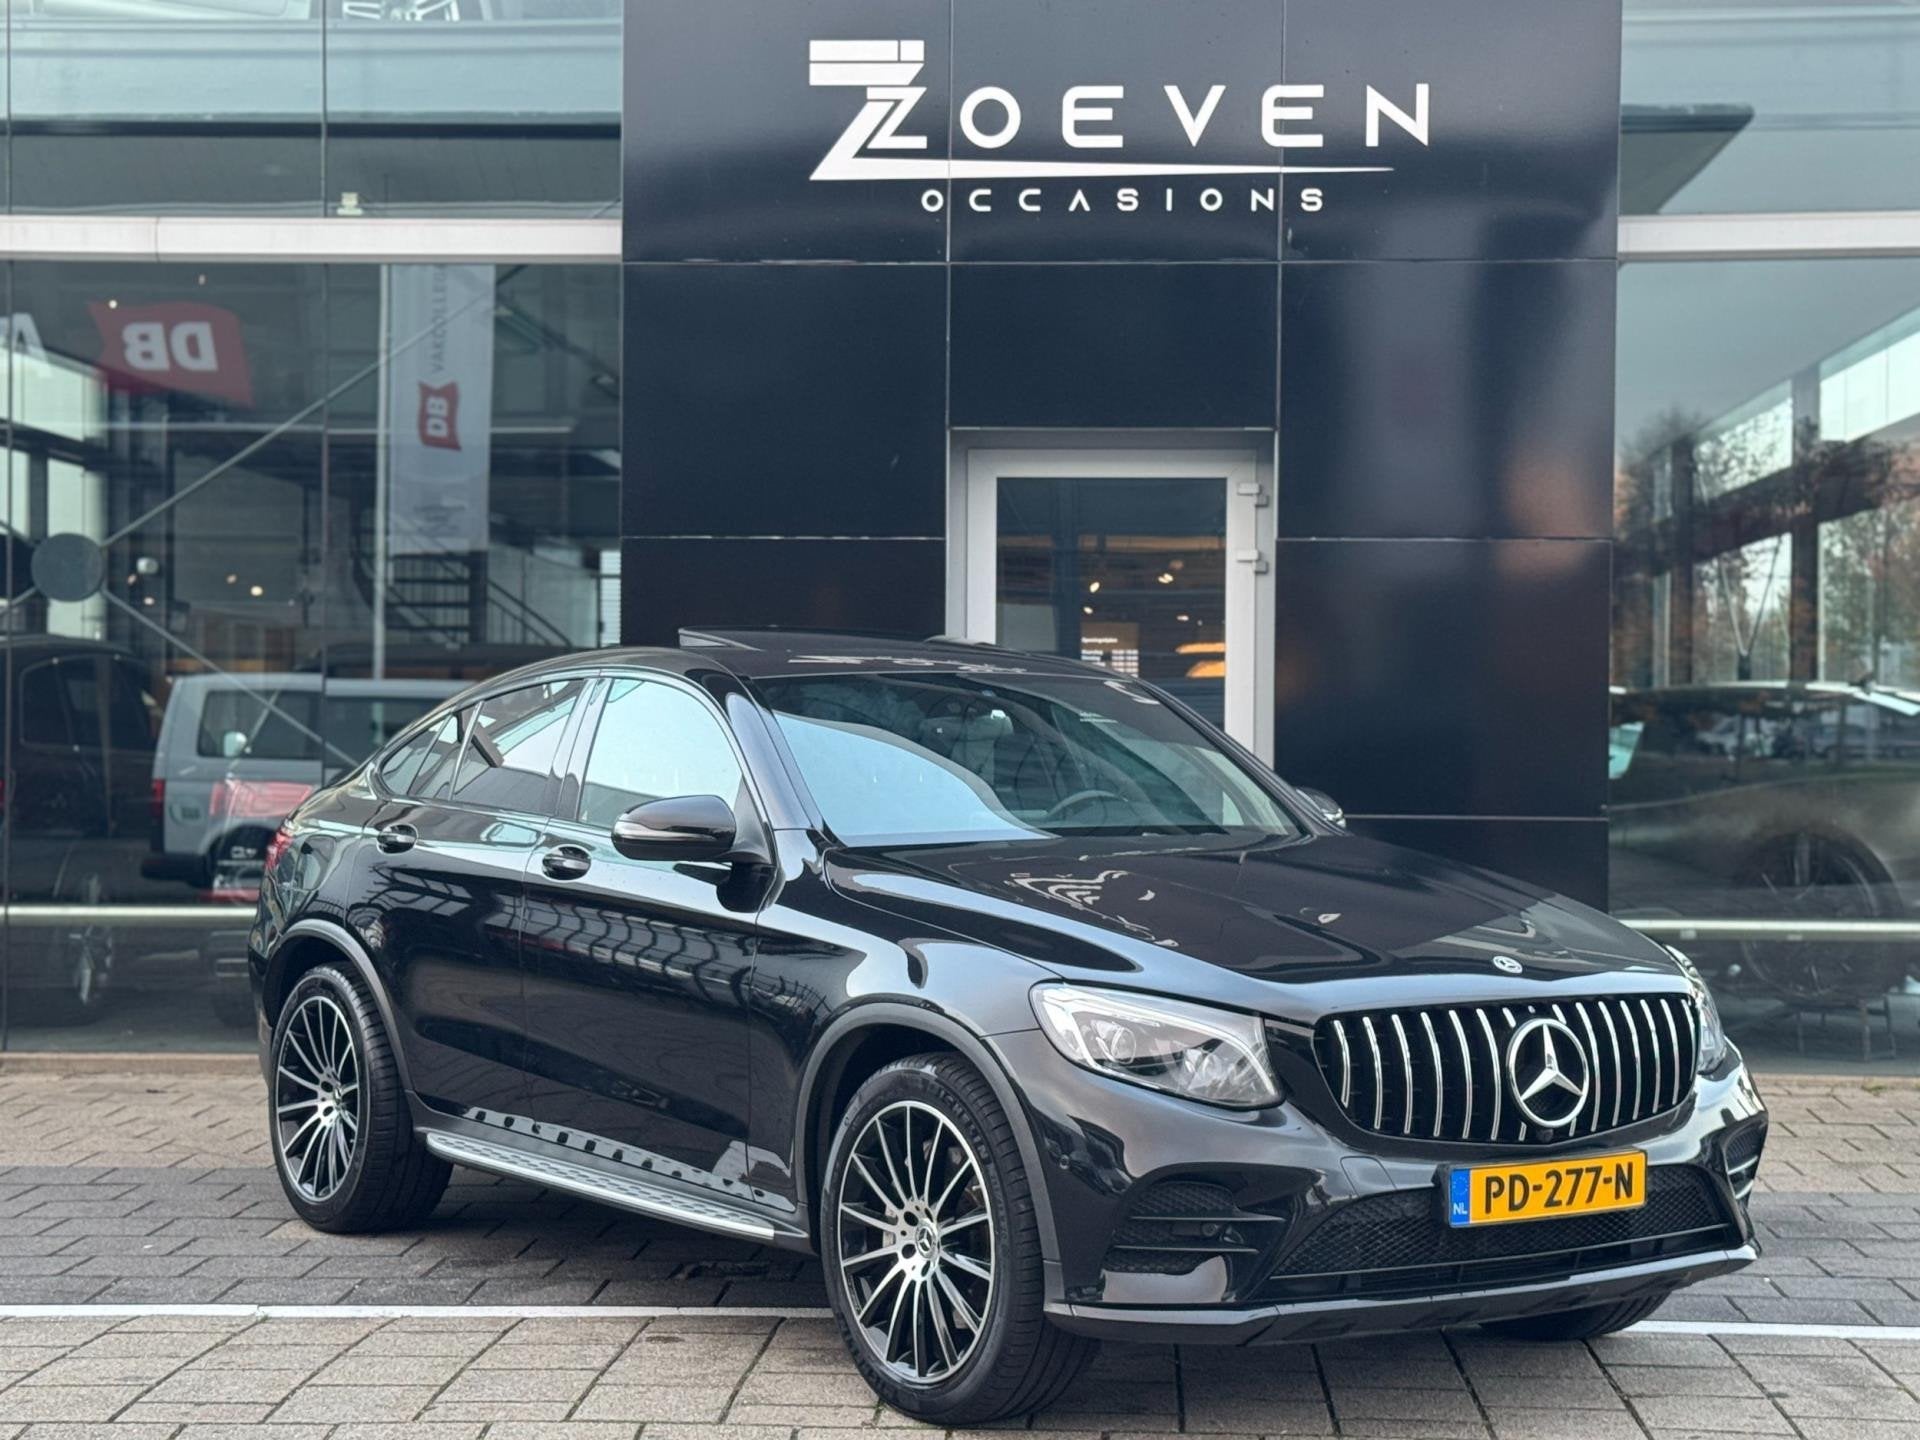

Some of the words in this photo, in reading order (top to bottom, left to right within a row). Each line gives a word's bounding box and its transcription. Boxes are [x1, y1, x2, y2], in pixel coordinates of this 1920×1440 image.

[809, 39, 1430, 181] ZOEVEN
[921, 187, 1325, 213] OCCASIONS
[426, 396, 449, 437] DB
[1484, 1161, 1634, 1214] PD-277-N
[1453, 1202, 1468, 1215] NL
